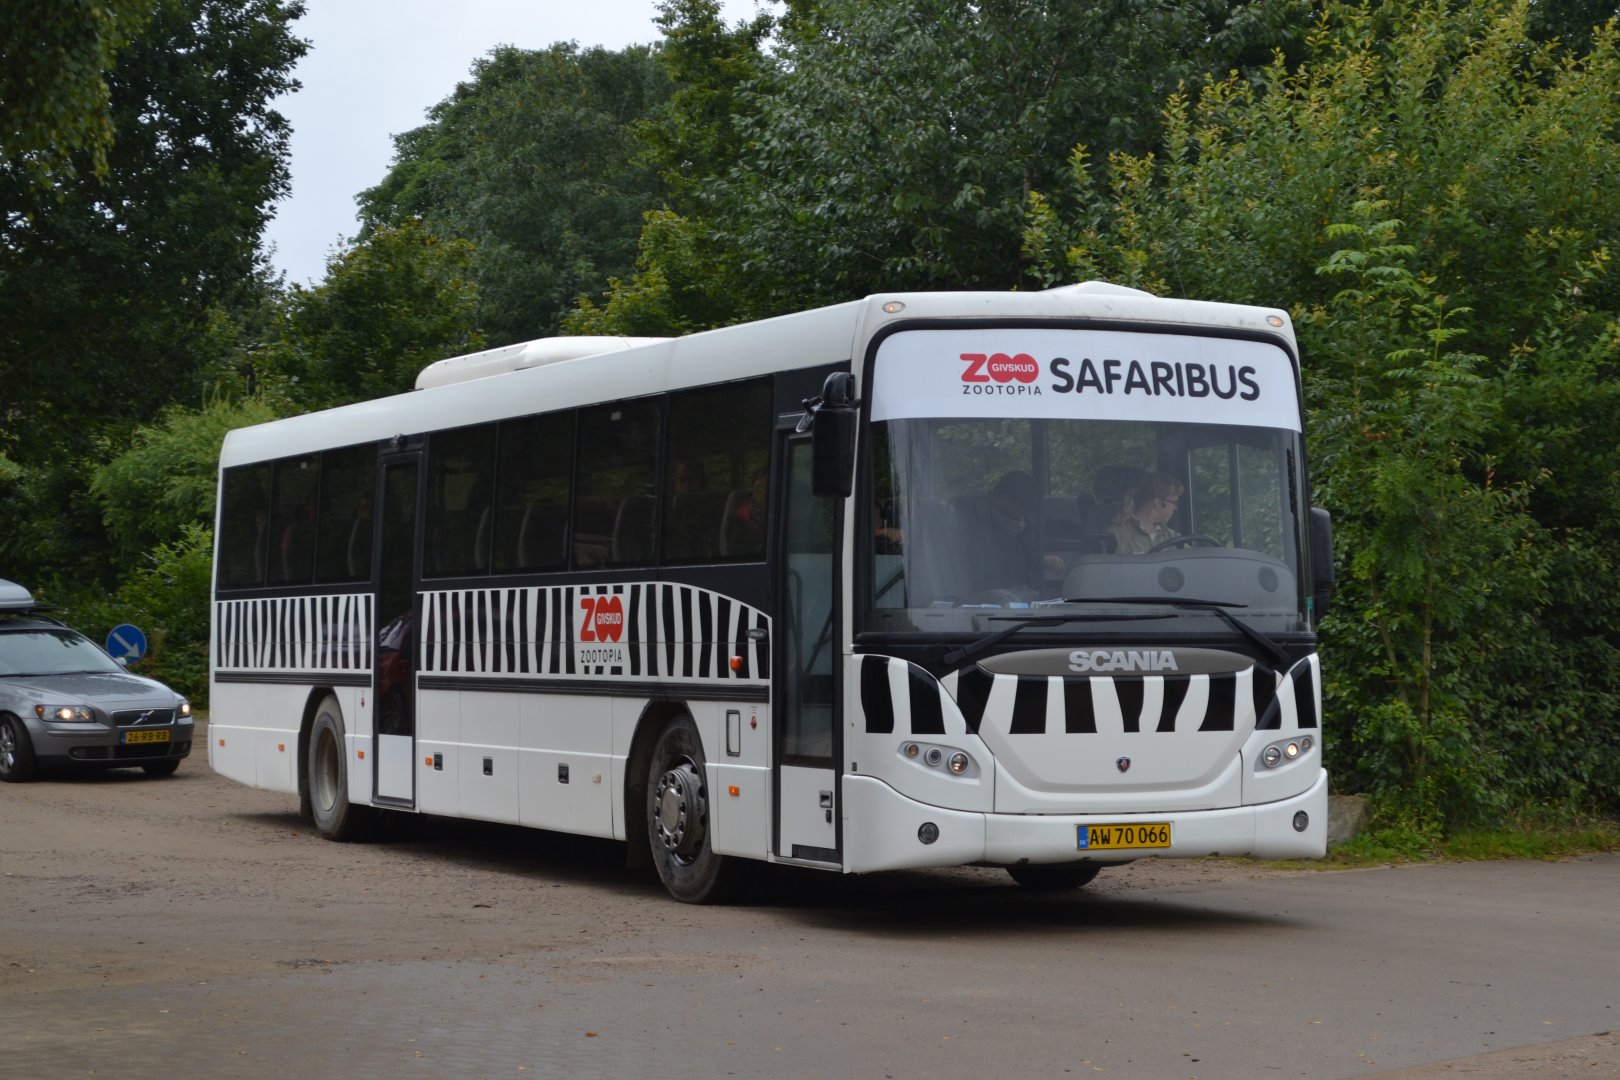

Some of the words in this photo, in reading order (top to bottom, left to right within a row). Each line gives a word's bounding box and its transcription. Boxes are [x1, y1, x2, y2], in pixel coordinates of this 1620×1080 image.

[959, 353, 1039, 383] ZOO
[991, 363, 1035, 372] GIVSKUD
[1050, 357, 1260, 401] SAFARIBUS
[962, 384, 1042, 396] ZOOTOPIA
[580, 595, 624, 643] ZOO
[597, 612, 622, 625] GIVSKUD
[580, 648, 623, 664] ZOOTOPIA
[1068, 650, 1179, 672] SCANIA
[127, 731, 168, 742] 26-RB-RB
[1089, 828, 1111, 845] AW
[1114, 828, 1134, 844] 70
[1138, 826, 1168, 843] 066
